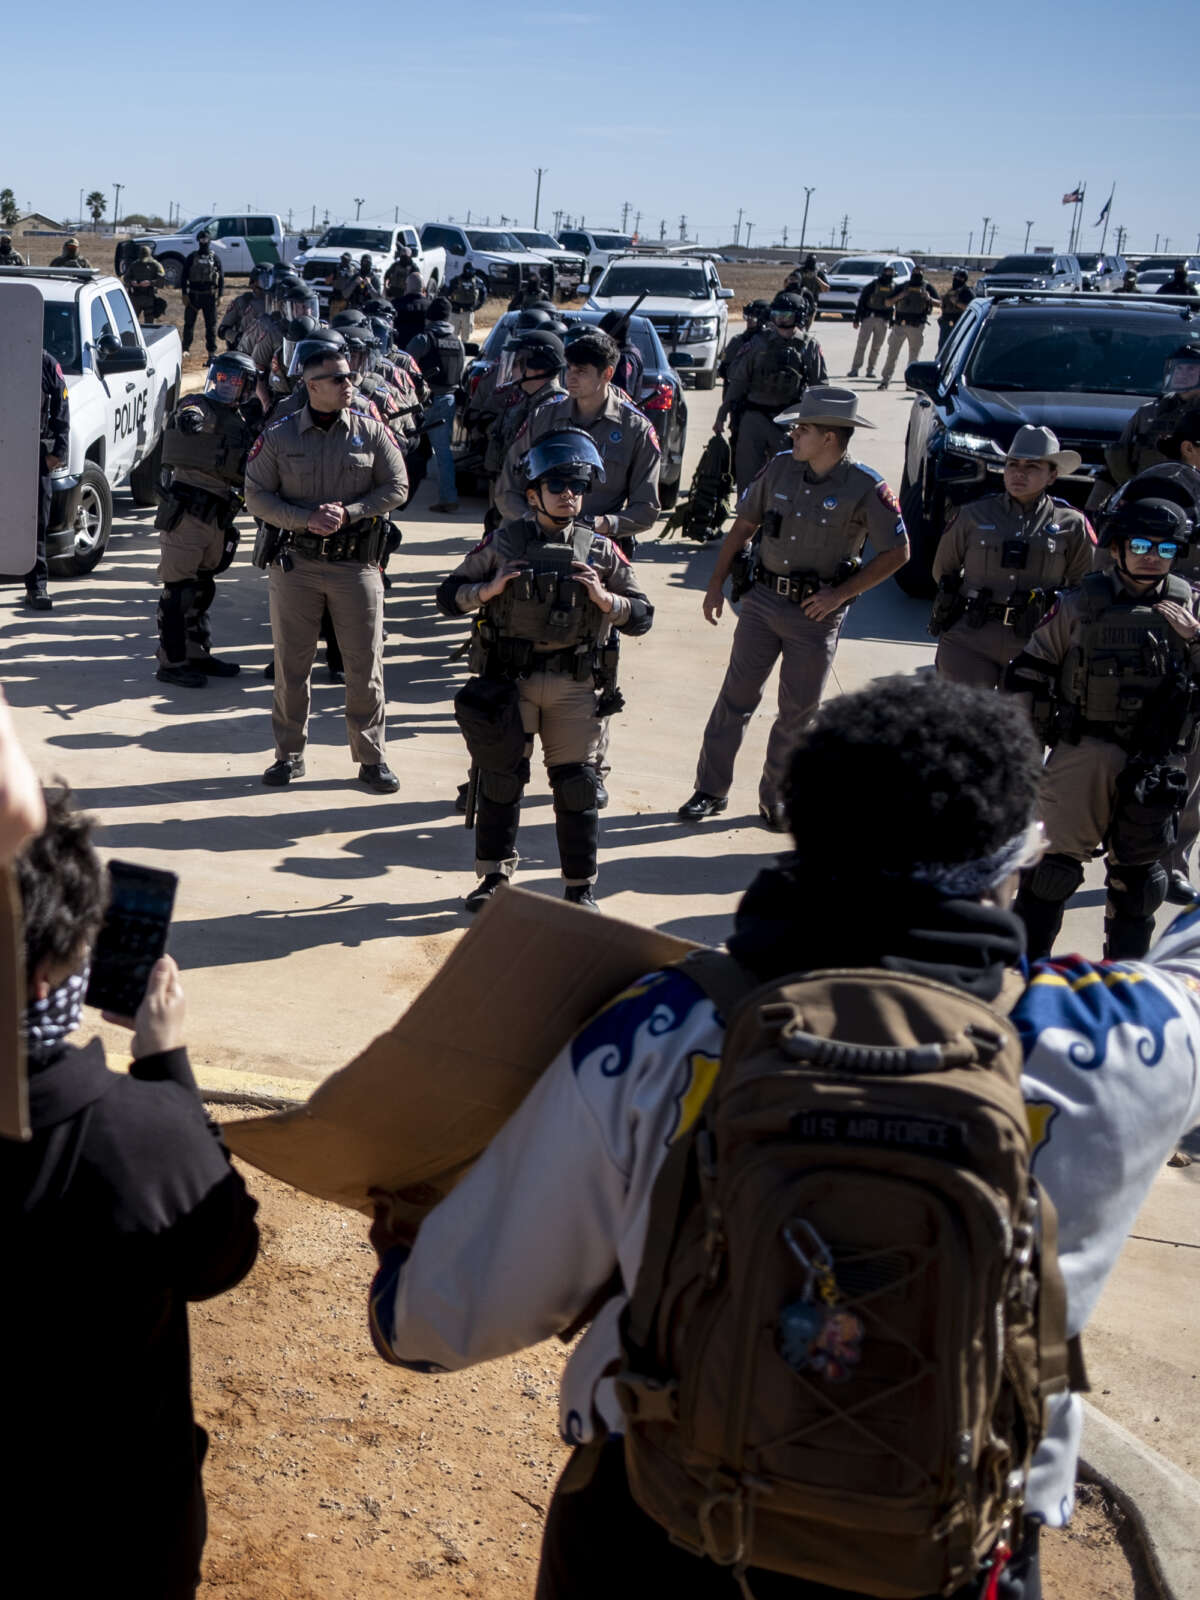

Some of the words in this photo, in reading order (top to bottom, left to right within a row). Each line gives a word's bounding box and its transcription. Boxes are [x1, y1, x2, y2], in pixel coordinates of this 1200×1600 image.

[113, 389, 148, 443] POLICE
[847, 1119, 879, 1140] AIR
[883, 1122, 949, 1146] FORCE
